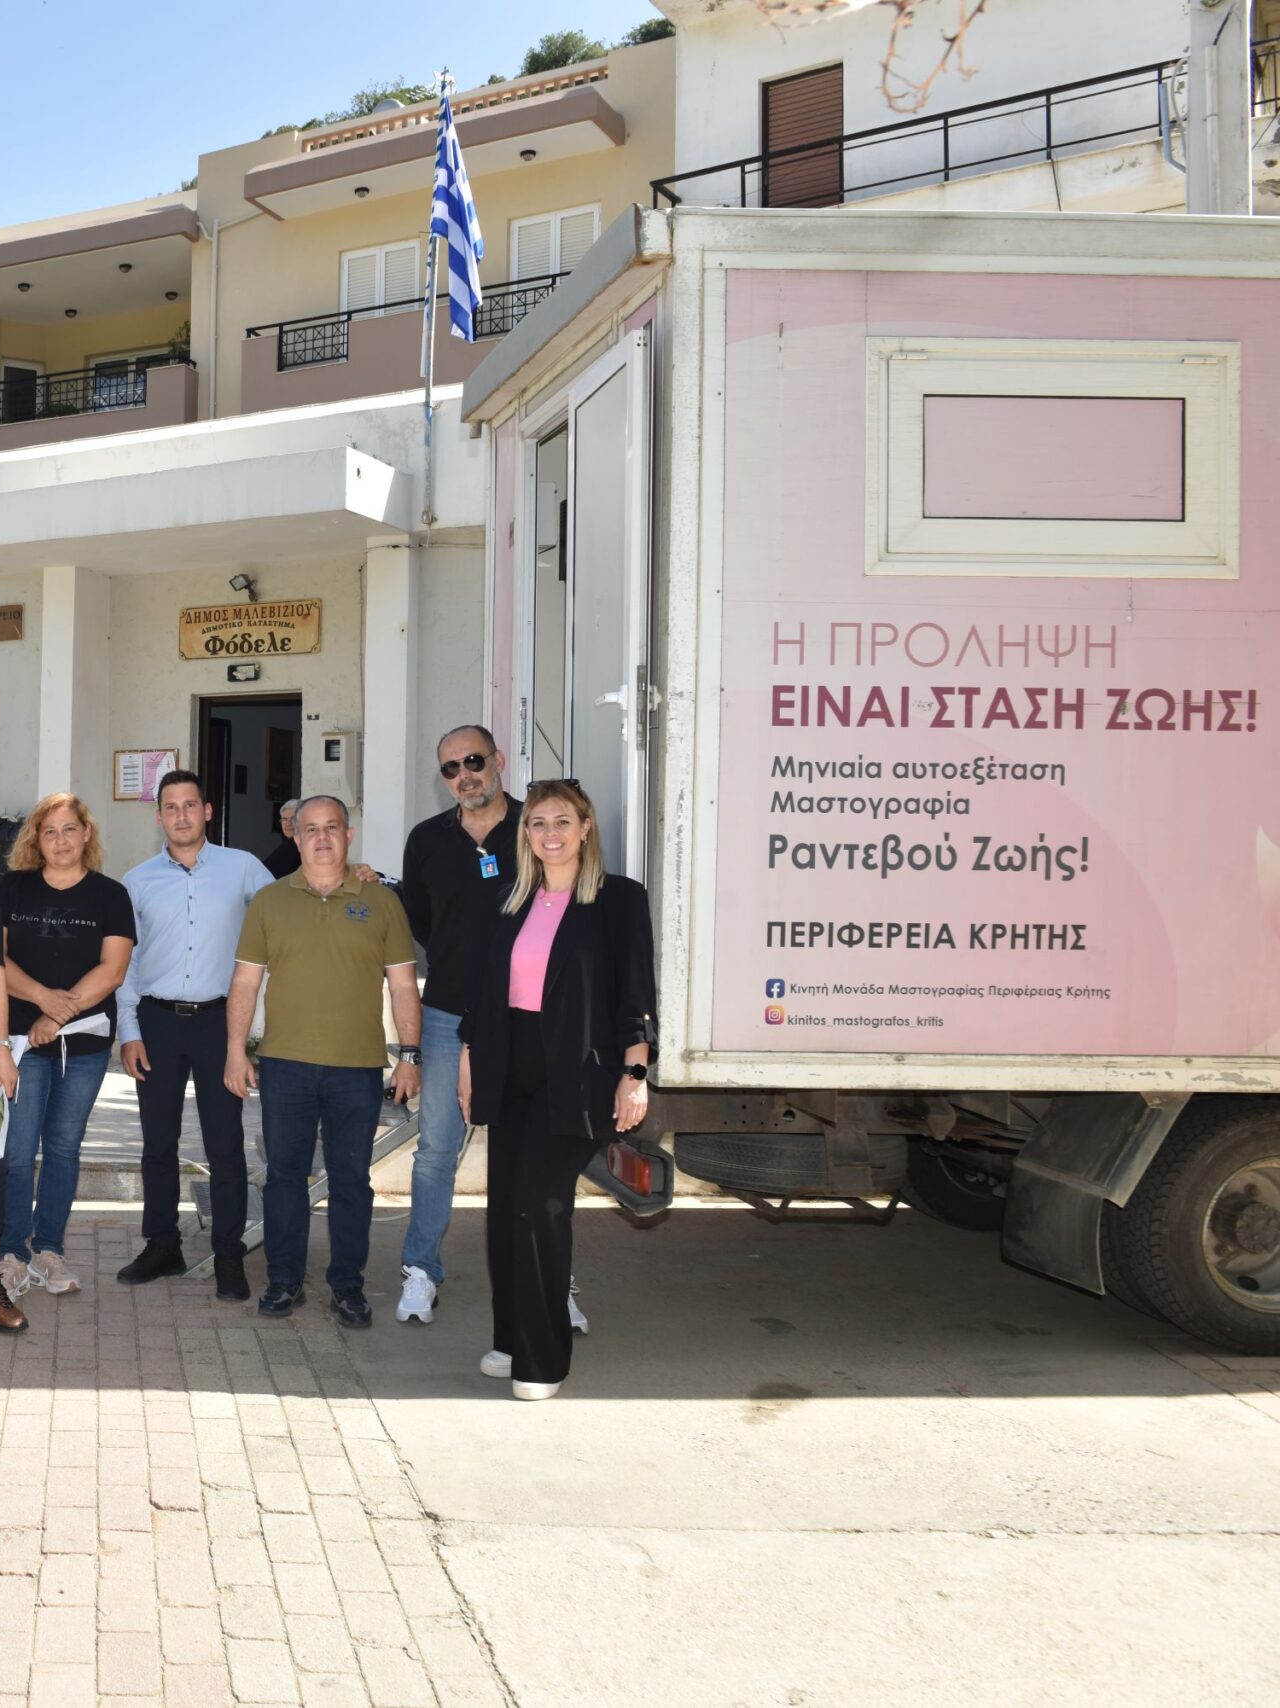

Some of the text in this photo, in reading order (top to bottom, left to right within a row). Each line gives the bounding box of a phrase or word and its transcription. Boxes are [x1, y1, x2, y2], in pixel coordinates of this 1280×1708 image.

[185, 603, 313, 624] ΔΗΜΟΣ ΜΑΛΕΒΙΖΙΟΥ
[201, 620, 296, 635] ΔΗΜΟΤΙΚΟ ΚΑΤΑΣΤΗΜΑ
[204, 631, 292, 656] Φόδελε
[773, 621, 1118, 669] Η ΠΡΟΛΗΨΗ
[771, 685, 1257, 733] ΕΙΝΑΙ ΣΤΑΣΗ ΖΩΗΣ!
[770, 754, 1066, 786] Μηνιαία αυτοεξέταση
[770, 790, 971, 820] Μαστογραφία
[768, 832, 1090, 882] Ραντεβού Ζωής!
[766, 920, 1087, 951] ΠΕΡΙΦΕΡΕΙΑ ΚΡΗΤΗΣ
[790, 983, 1112, 999] Κινητή Μονάδα Μαστογραφίας Περιφέρειας Κρήτης
[787, 1014, 944, 1028] kinitos_mastografos_kritis
